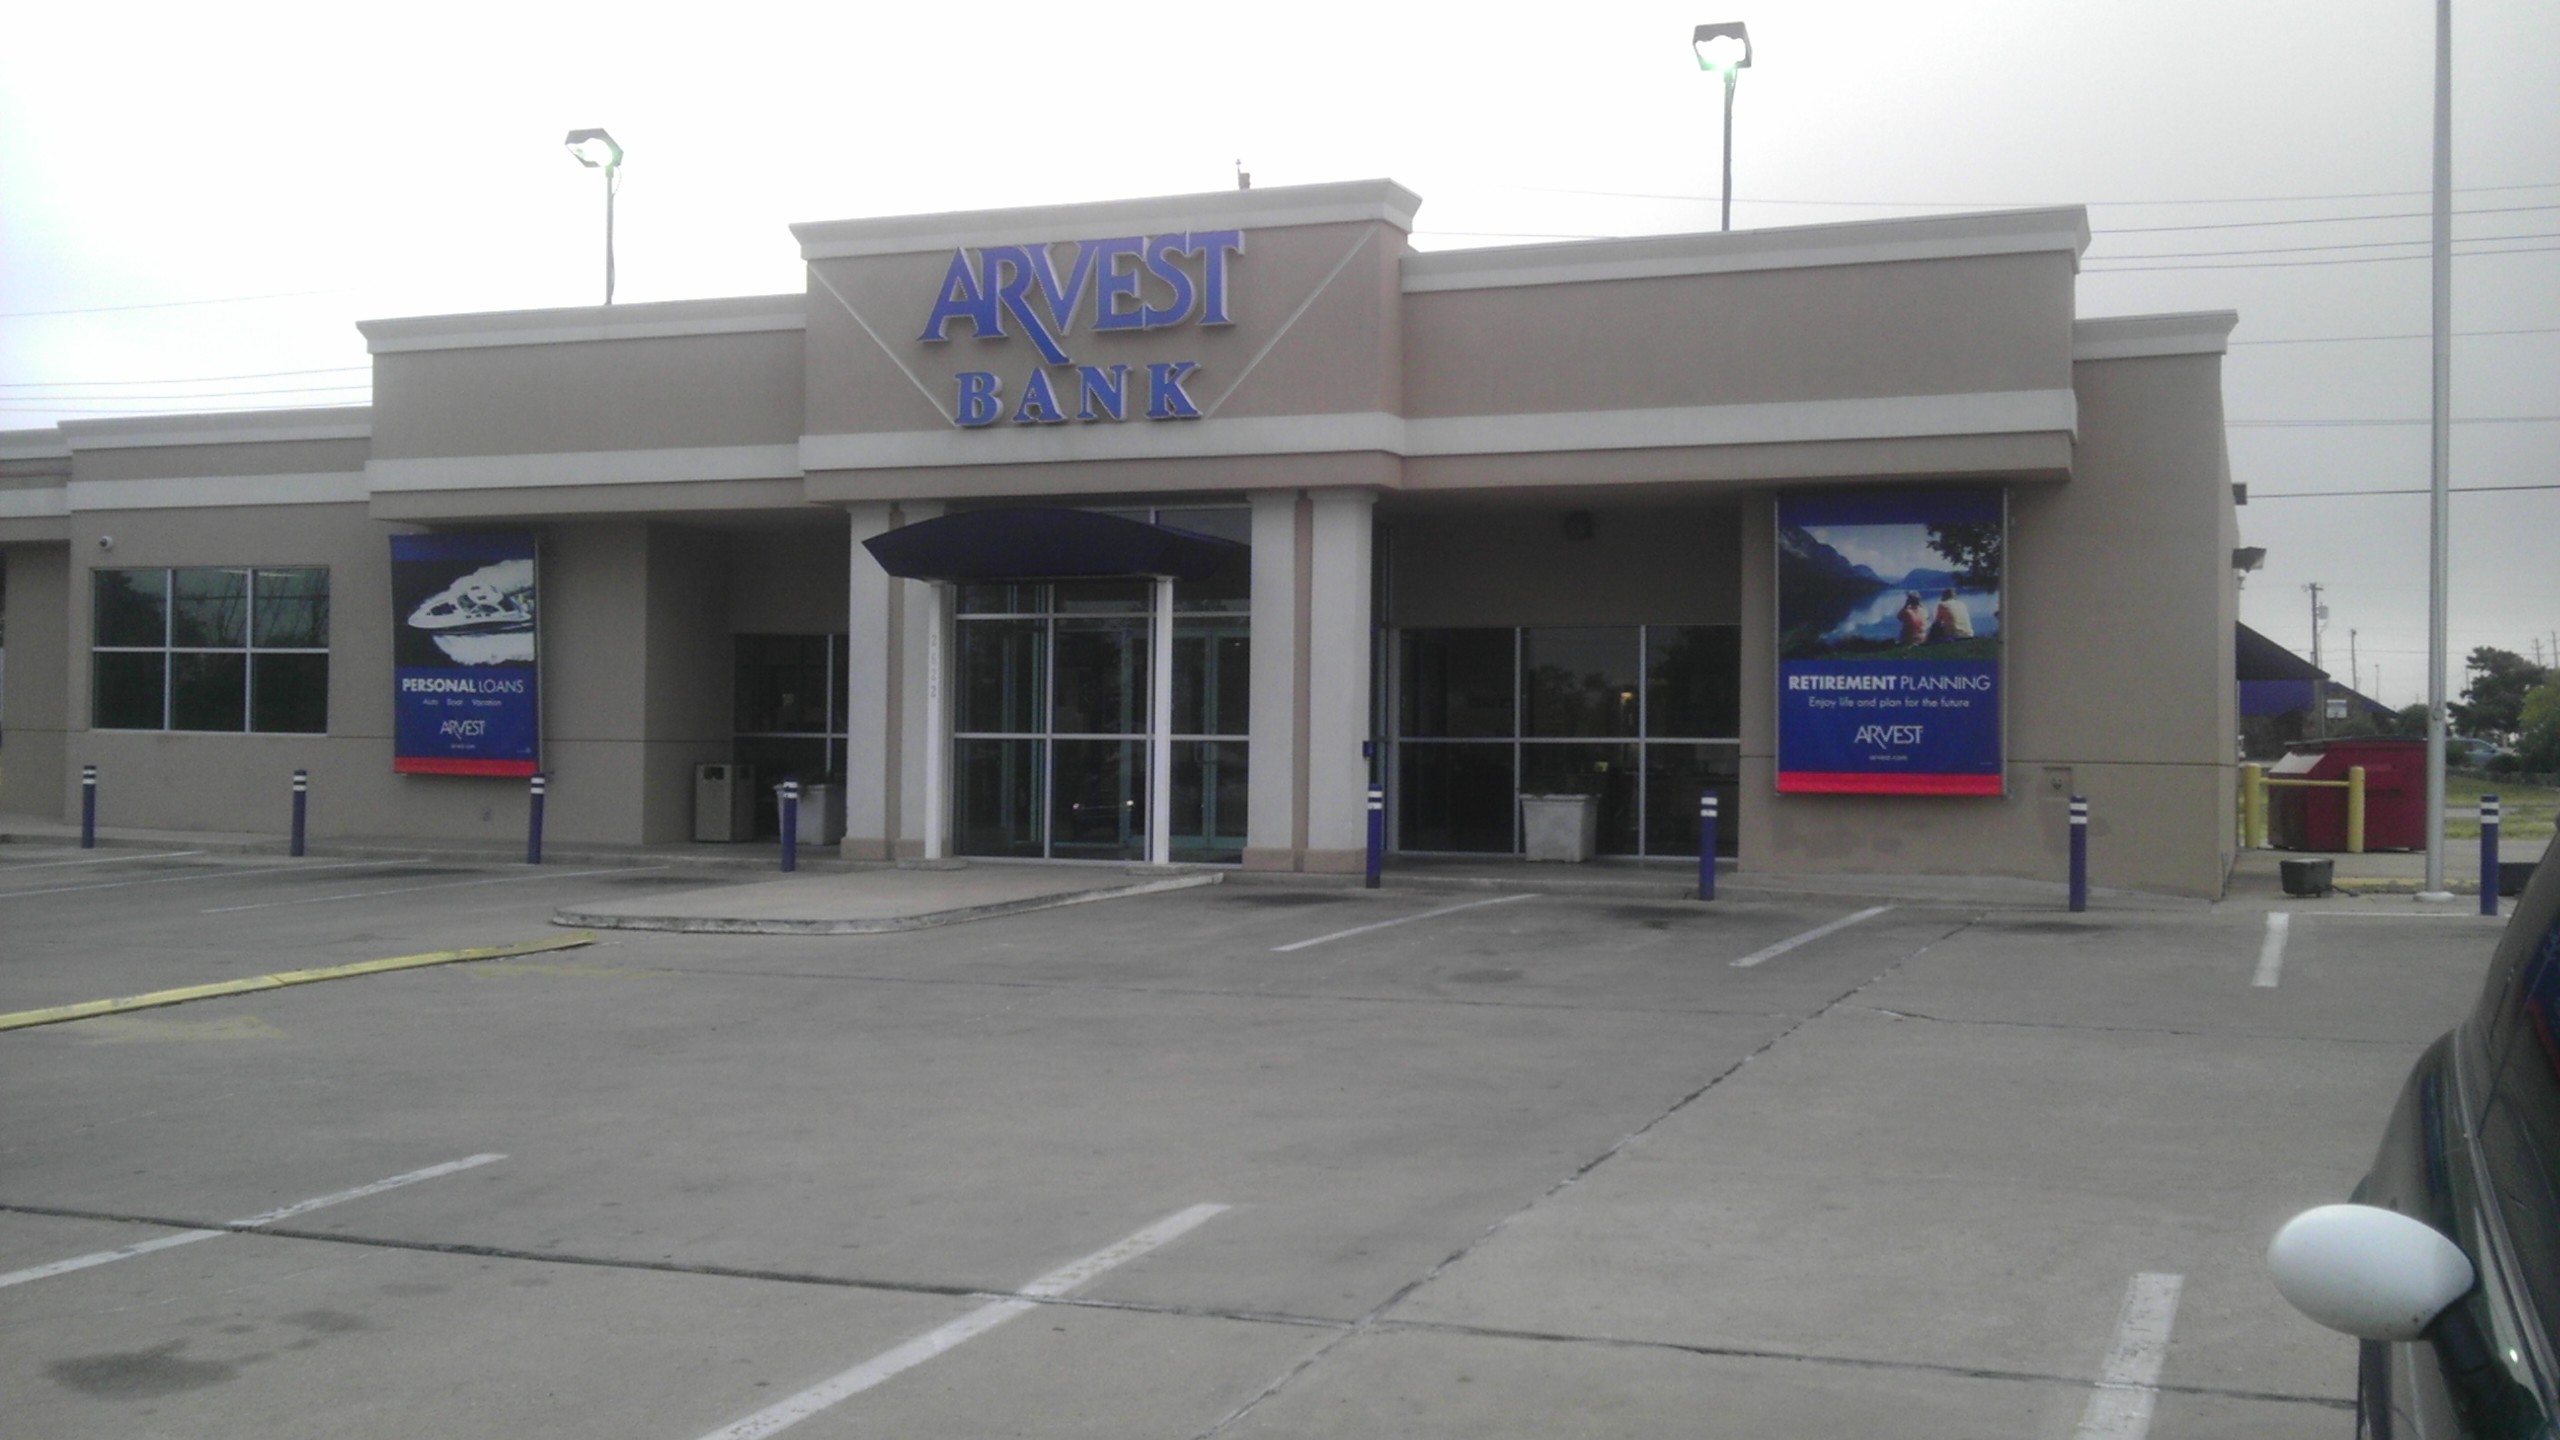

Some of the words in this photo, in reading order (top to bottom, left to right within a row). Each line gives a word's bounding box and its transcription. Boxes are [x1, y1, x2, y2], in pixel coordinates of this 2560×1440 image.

[916, 230, 1245, 365] ARVEST
[954, 361, 1203, 426] BANK
[402, 678, 476, 693] PERSONAL
[479, 679, 524, 694] LOANS
[1788, 675, 1897, 691] RETIREMENT
[1900, 675, 1991, 691] PLANNING
[1808, 696, 1836, 709] Enjoy
[1839, 696, 1854, 708] life
[1857, 697, 1876, 708] and
[1879, 696, 1900, 709] plan
[1904, 696, 1919, 708] for
[1922, 697, 1938, 708] the
[1940, 697, 1969, 708] future
[440, 719, 486, 741] ARVEST
[1854, 725, 1924, 750] ARVEST
